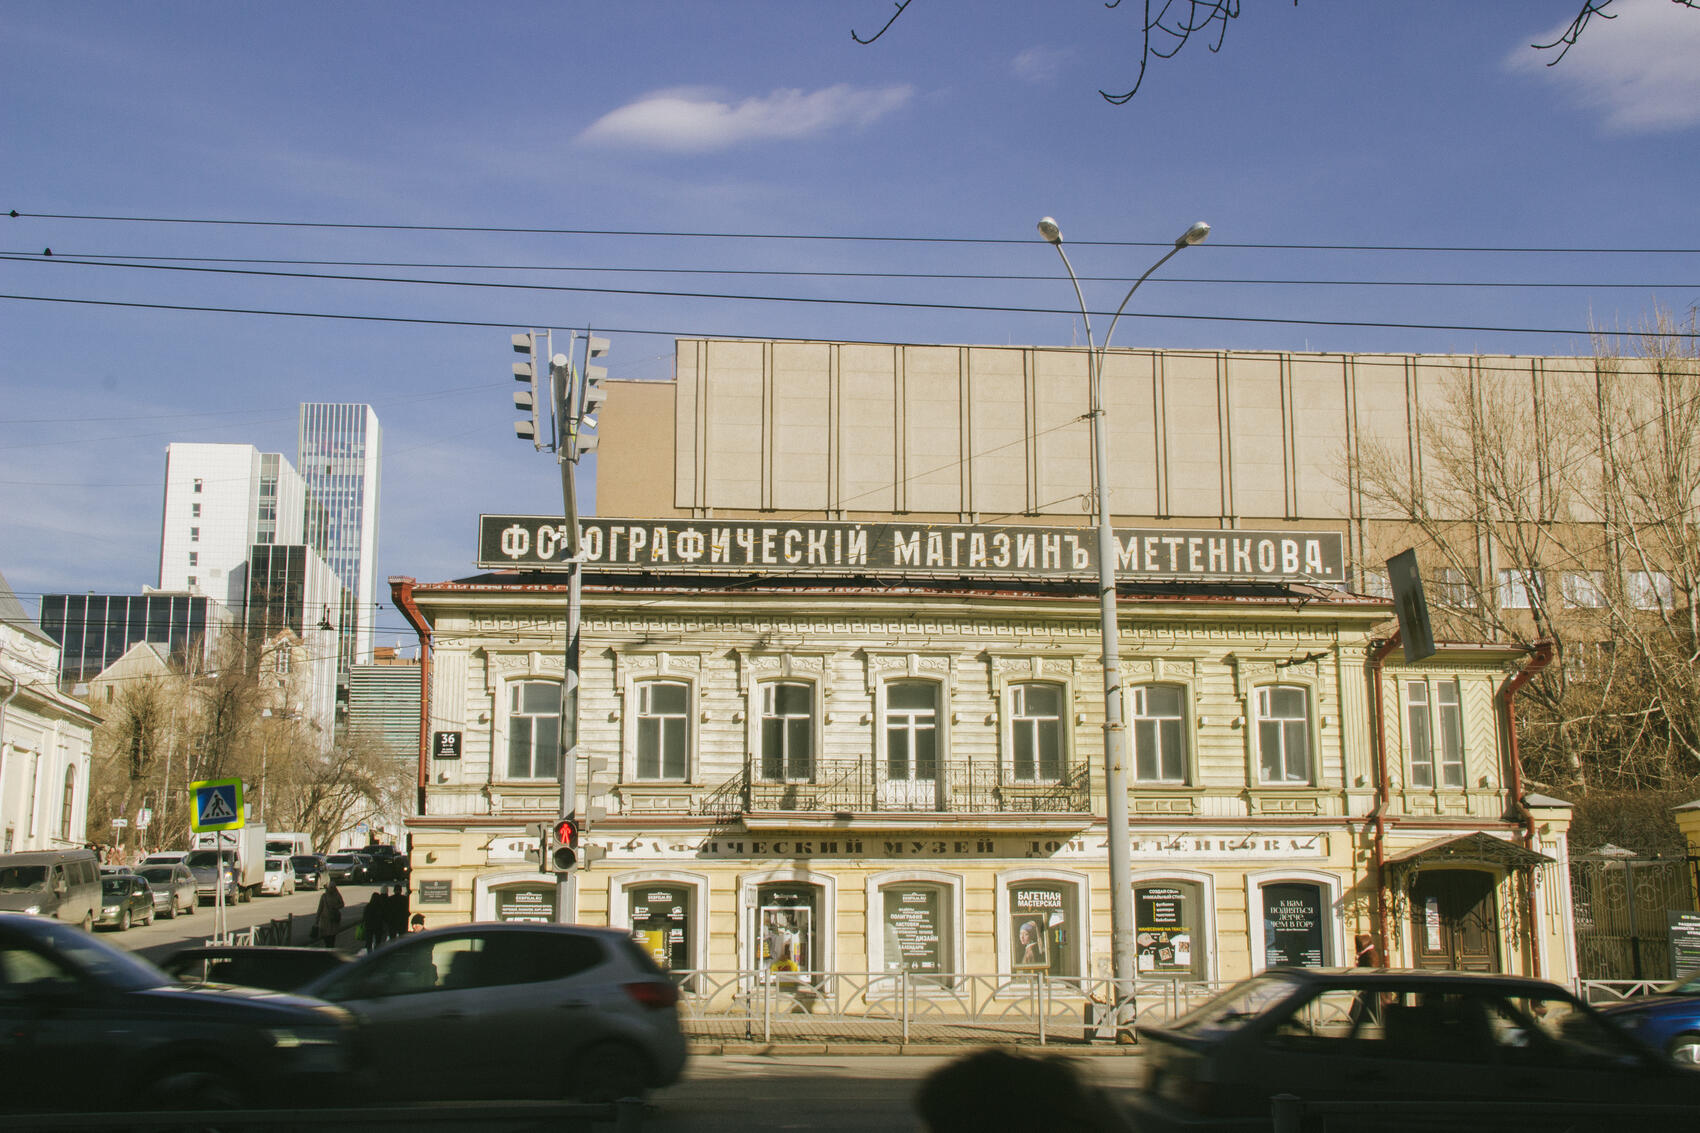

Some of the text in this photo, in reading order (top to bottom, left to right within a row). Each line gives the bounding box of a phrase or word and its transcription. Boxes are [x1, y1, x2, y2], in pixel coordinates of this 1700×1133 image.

[893, 530, 1090, 570] МАГАЗИНЪ
[1112, 535, 1332, 575] МЕТЕНКОВА.
[441, 733, 455, 744] 36
[883, 838, 995, 855] МУЗЕЙ
[1024, 840, 1085, 859] ДОМ
[1131, 839, 1302, 852] ЕТЕНКОВА
[1017, 891, 1062, 901] БАГЕТНАЯ
[915, 934, 939, 942] ДИЗАЙН
